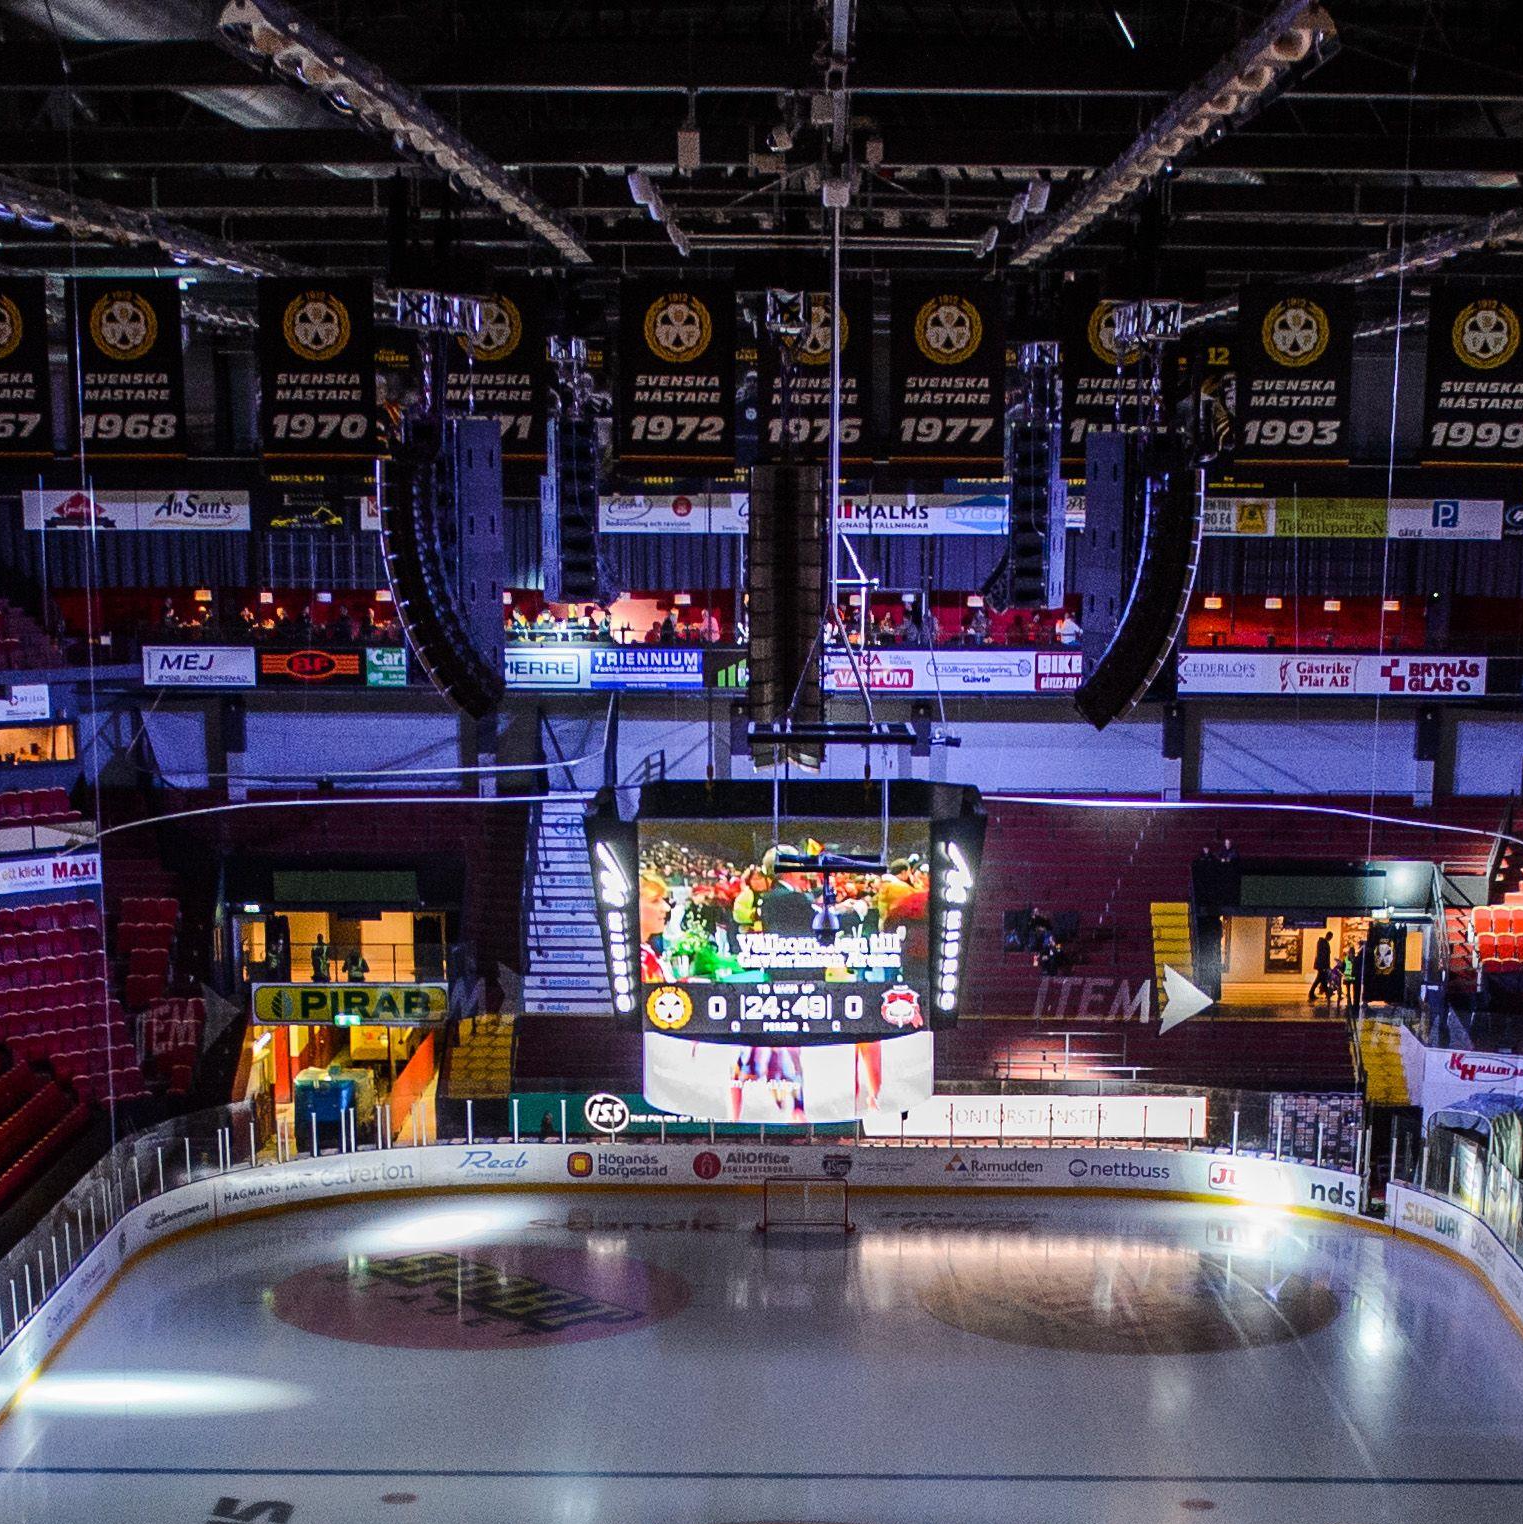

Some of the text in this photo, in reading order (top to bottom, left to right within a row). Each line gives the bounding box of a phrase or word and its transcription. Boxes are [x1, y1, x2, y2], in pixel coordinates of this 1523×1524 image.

[1208, 347, 1230, 365] 12
[84, 373, 169, 385] SVENSKA
[276, 373, 361, 386] SVENSKA
[635, 375, 720, 388] SVENSKA
[906, 376, 990, 389] SVENSKA
[1251, 379, 1336, 391] SVENSKA
[83, 413, 177, 440] 1968
[272, 413, 368, 440] 1970
[631, 416, 725, 441] 1972
[768, 417, 862, 443] 1976
[900, 417, 994, 443] 1977
[1244, 420, 1341, 446] 1993
[856, 505, 929, 520] MALMS
[160, 653, 215, 671] MEJ
[595, 652, 699, 666] TRIENNIUM
[1296, 661, 1352, 675] Gästrike
[1184, 662, 1256, 675] CEDERLÖFS
[1408, 660, 1480, 677] BRYNÄS
[962, 675, 991, 684] Gävle
[1299, 675, 1350, 688] Plåt AB
[1408, 678, 1454, 692] GLAS
[52, 861, 97, 880] MAXI
[301, 989, 434, 1019] PIRAB
[707, 995, 727, 1021] 0
[844, 995, 864, 1021] 0
[457, 1150, 529, 1169] Reab
[598, 1152, 659, 1166] Höganäs
[971, 1160, 1044, 1174] Ramudden
[320, 1160, 414, 1187] Caverion
[598, 1164, 668, 1177] Borgestad
[1090, 1162, 1171, 1180] nettbuss
[224, 1184, 281, 1204] HAGMANS
[1310, 1181, 1357, 1207] nds
